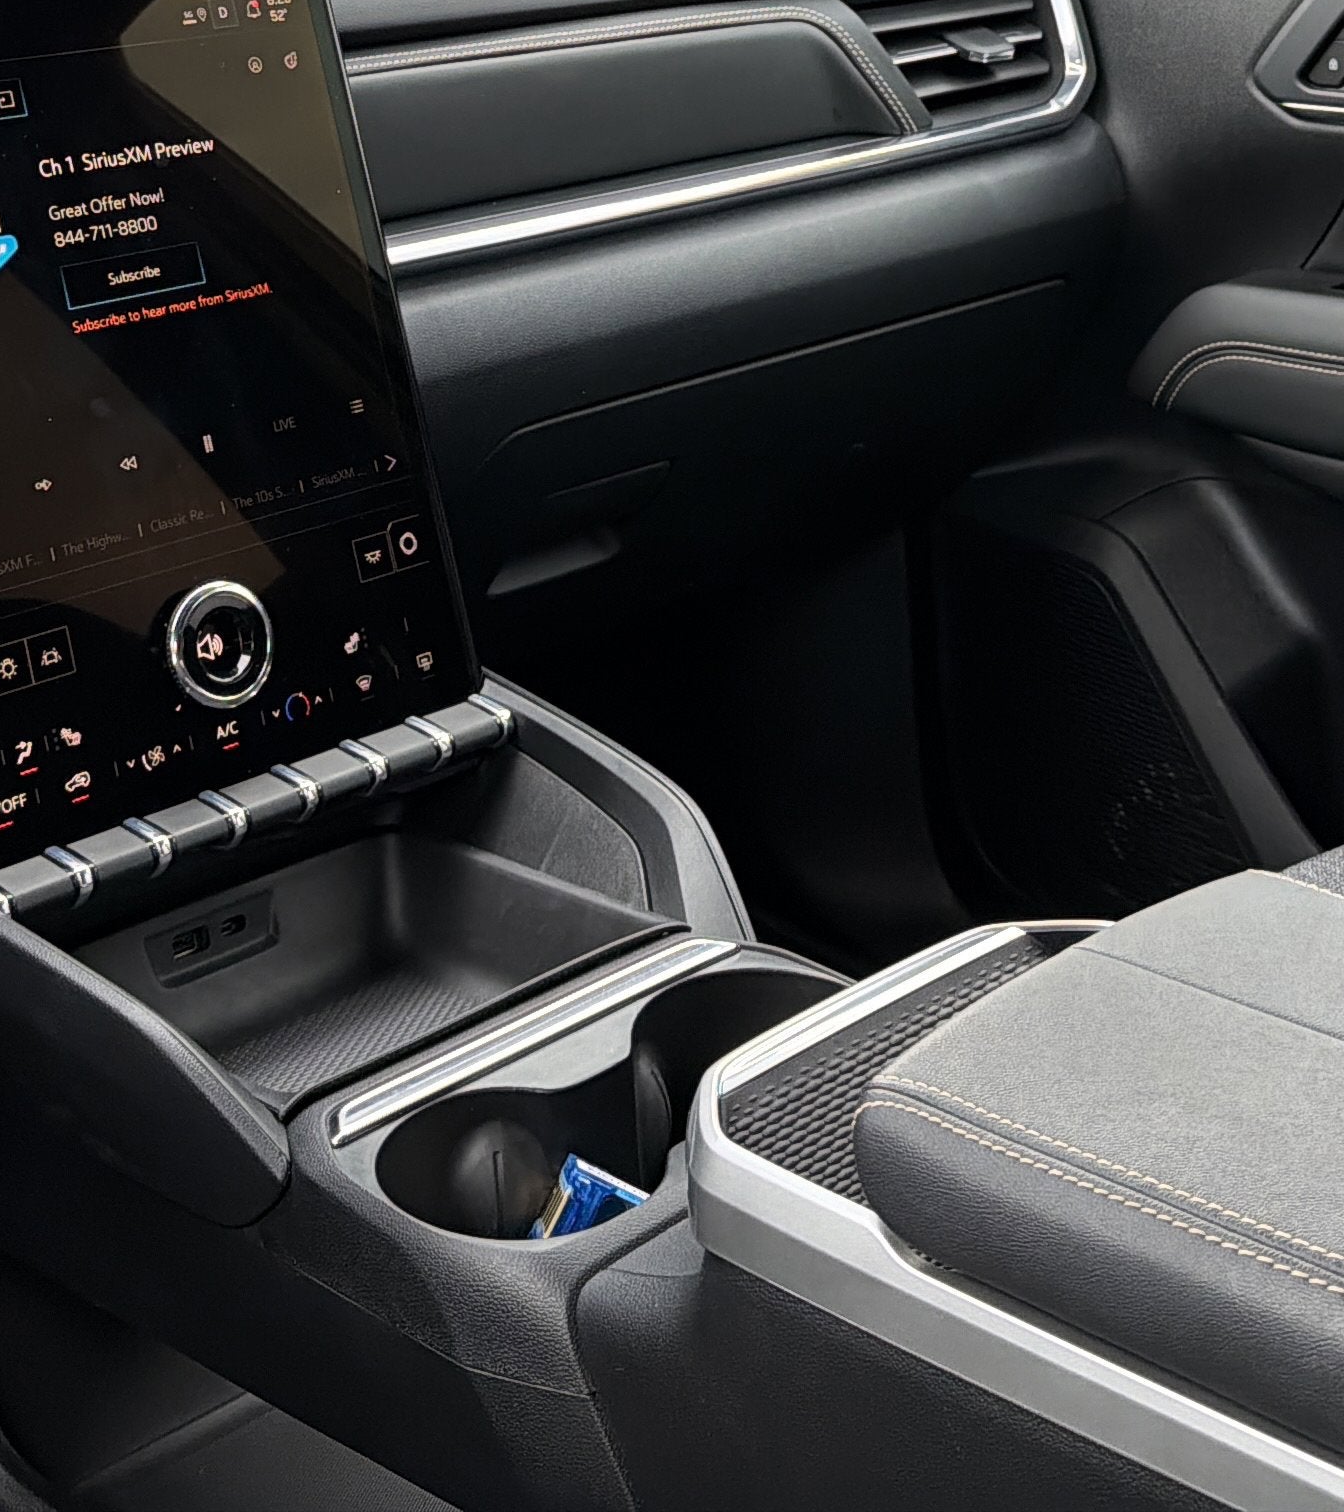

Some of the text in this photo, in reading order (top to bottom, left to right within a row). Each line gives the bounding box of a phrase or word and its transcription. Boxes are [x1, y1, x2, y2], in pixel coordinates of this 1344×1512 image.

[217, 6, 229, 19] D
[269, 7, 288, 22] 52°
[38, 138, 215, 178] Ch 1 SiriusXM Preview
[48, 187, 165, 221] Great Offer Now!
[53, 215, 158, 248] 844-711-8800
[107, 266, 161, 286] Subscribe
[72, 281, 274, 335] Subscribe to hear more from SiriusXM.
[273, 416, 297, 434] LIVE
[233, 496, 255, 510] The
[150, 514, 188, 534] Classic
[61, 542, 85, 557] The
[216, 720, 240, 740] A/C
